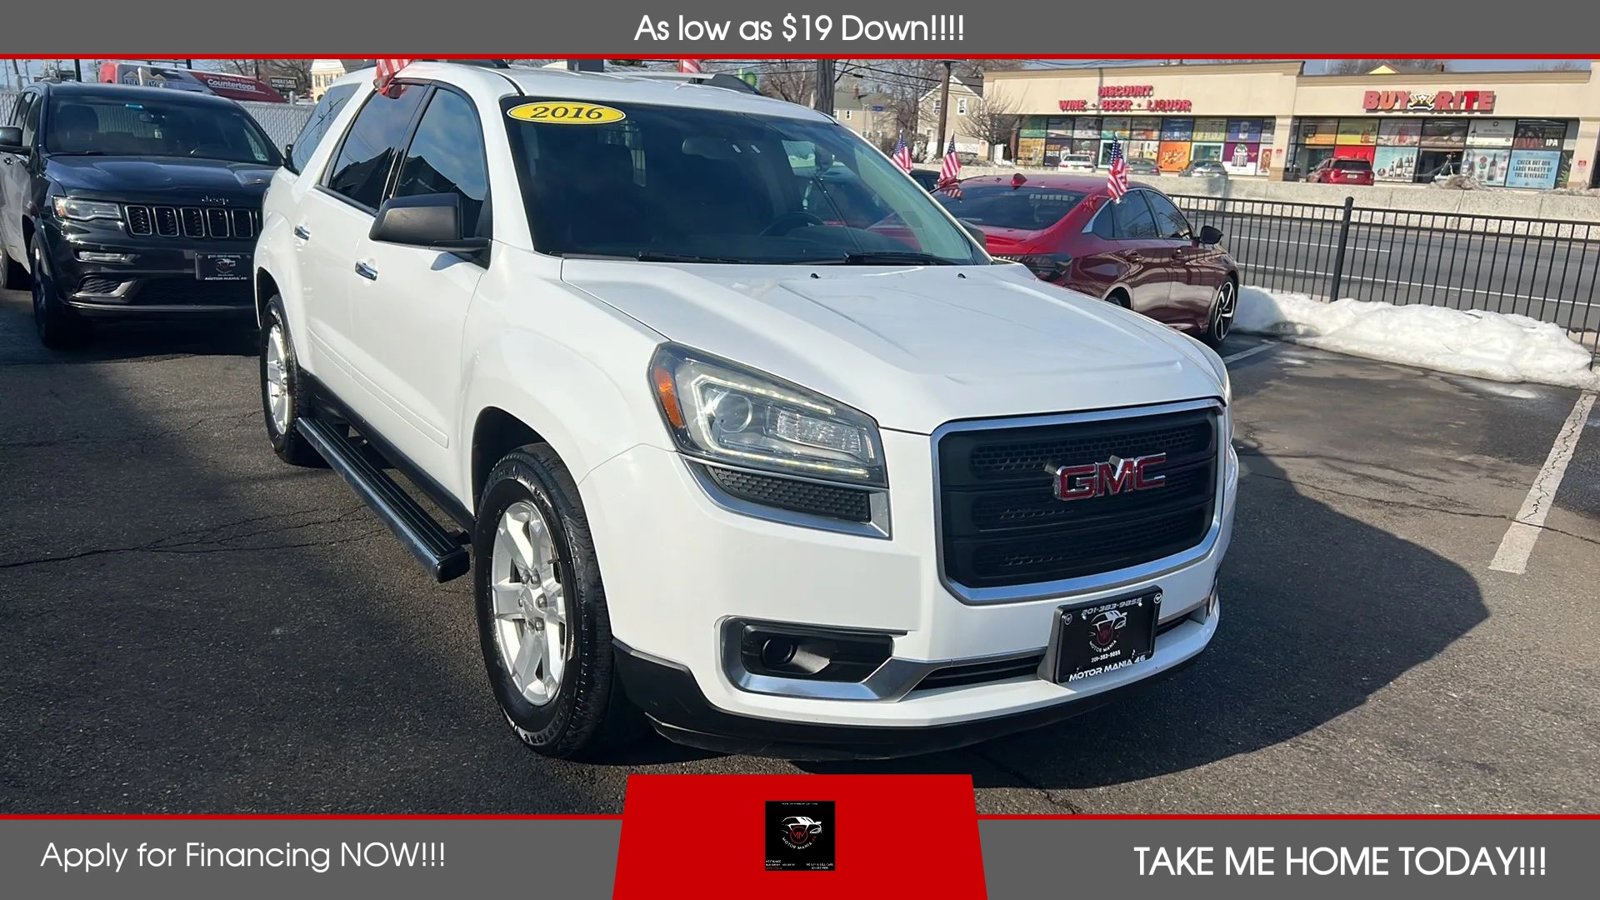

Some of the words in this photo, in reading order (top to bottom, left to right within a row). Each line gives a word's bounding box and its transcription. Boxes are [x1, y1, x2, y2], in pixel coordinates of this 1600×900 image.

[207, 78, 256, 91] Countertops
[1059, 100, 1087, 112] WINE
[1101, 100, 1133, 112] BEER
[1146, 100, 1192, 113] LIQUOR
[1363, 91, 1411, 110] BUY
[1434, 91, 1496, 112] RITE
[530, 106, 604, 120] 2016
[1545, 138, 1559, 147] IPA
[1055, 452, 1166, 501] GMC
[1069, 667, 1103, 682] MOTOR
[1104, 659, 1133, 673] MANIA
[1134, 654, 1146, 664] 46
